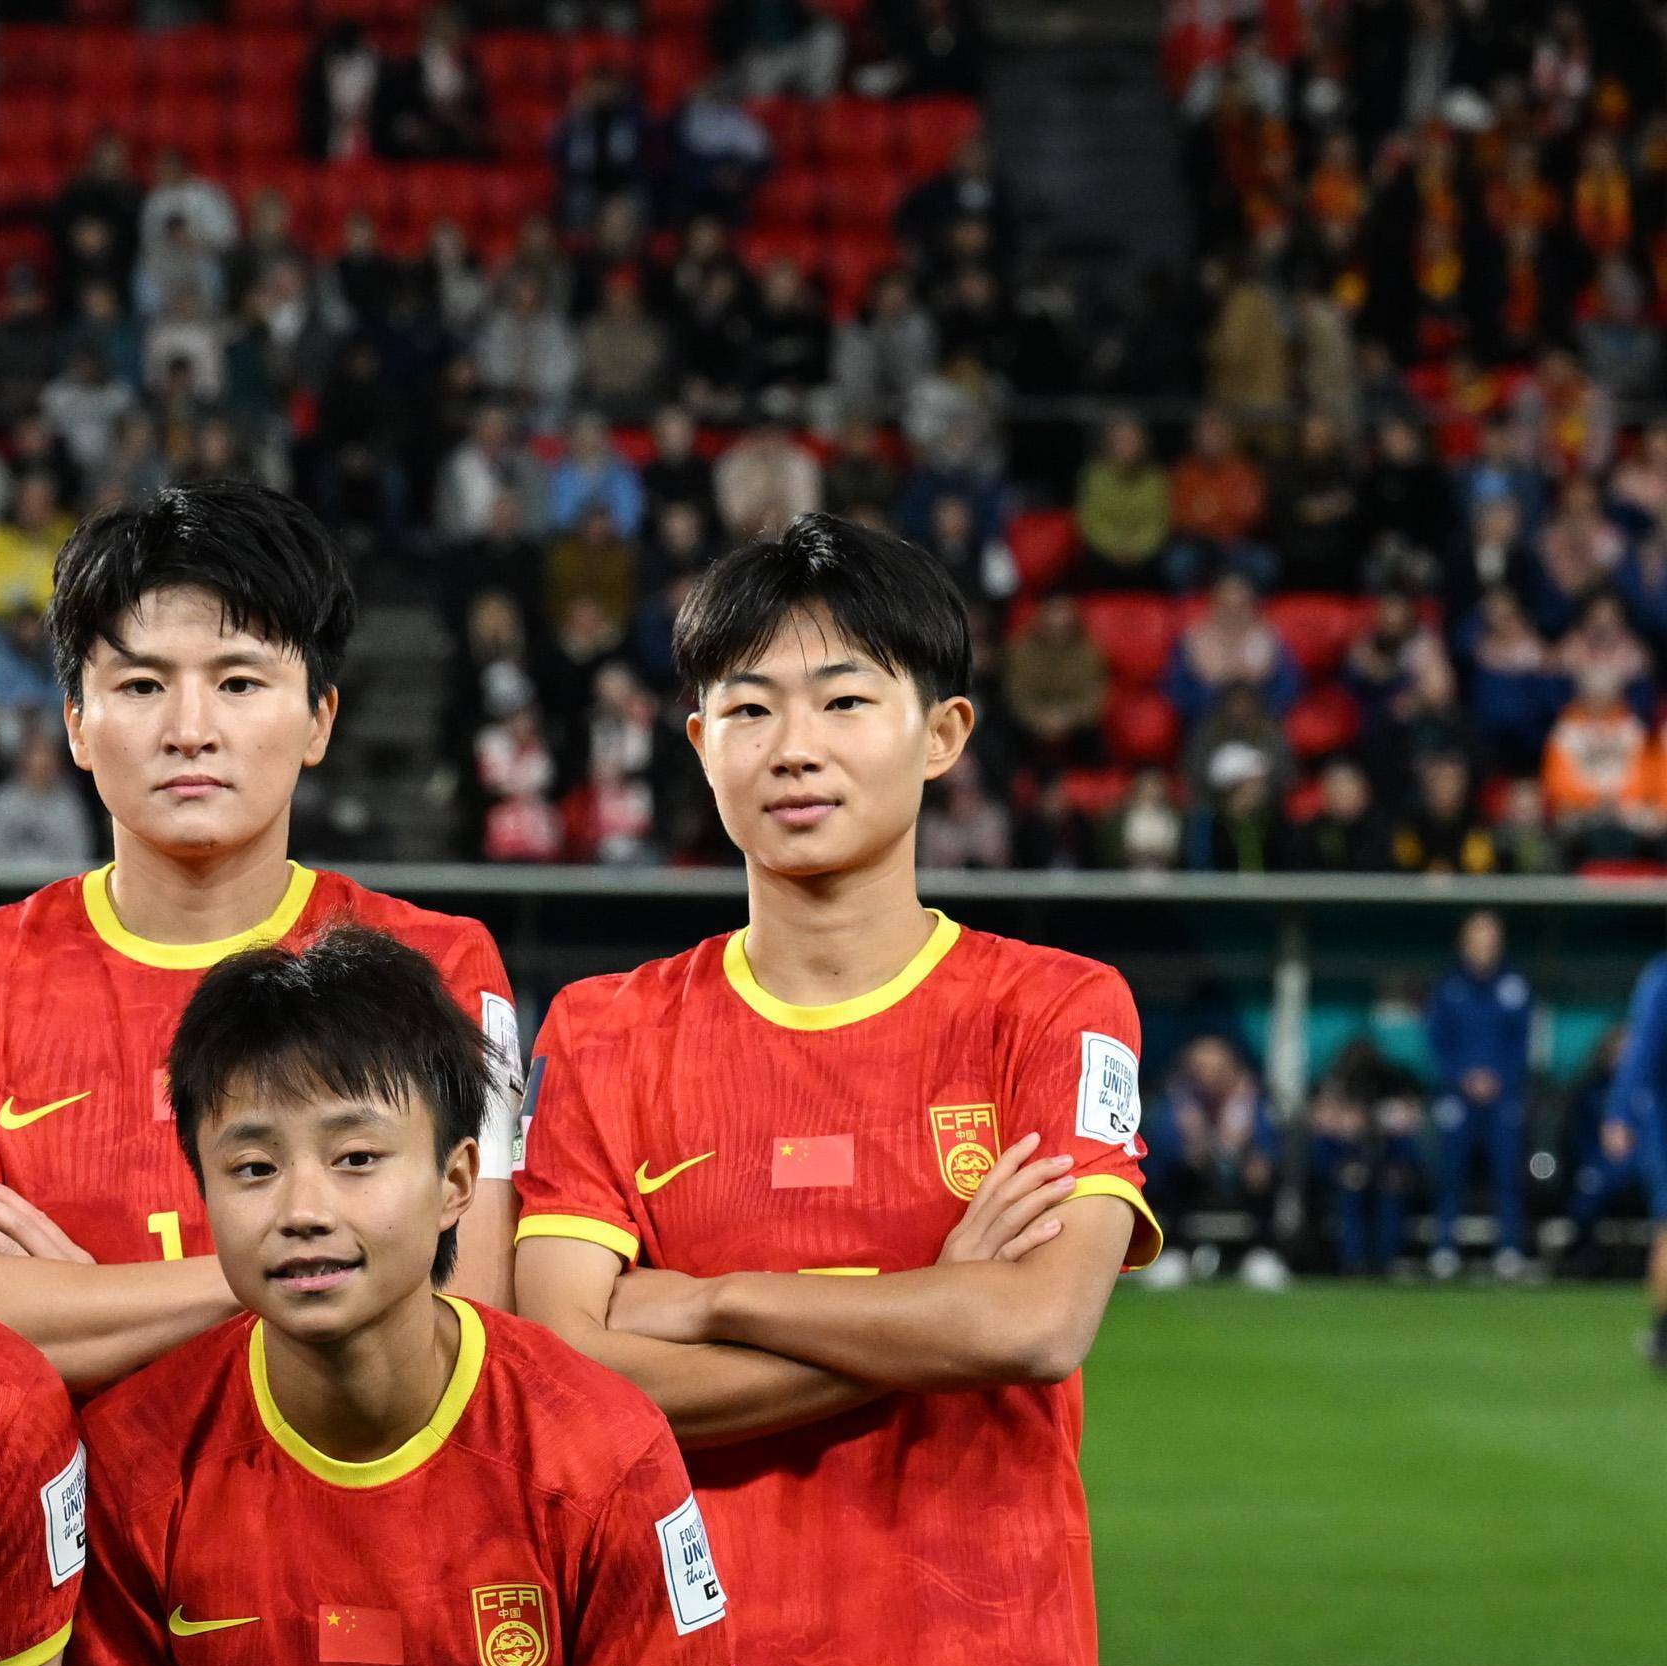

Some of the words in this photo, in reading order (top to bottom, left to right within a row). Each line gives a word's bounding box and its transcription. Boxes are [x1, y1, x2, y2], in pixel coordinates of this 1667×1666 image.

[1103, 1069, 1131, 1097] UNIT
[937, 1110, 991, 1130] CFA
[63, 1486, 85, 1522] UNIT
[479, 1590, 536, 1611] CFA
